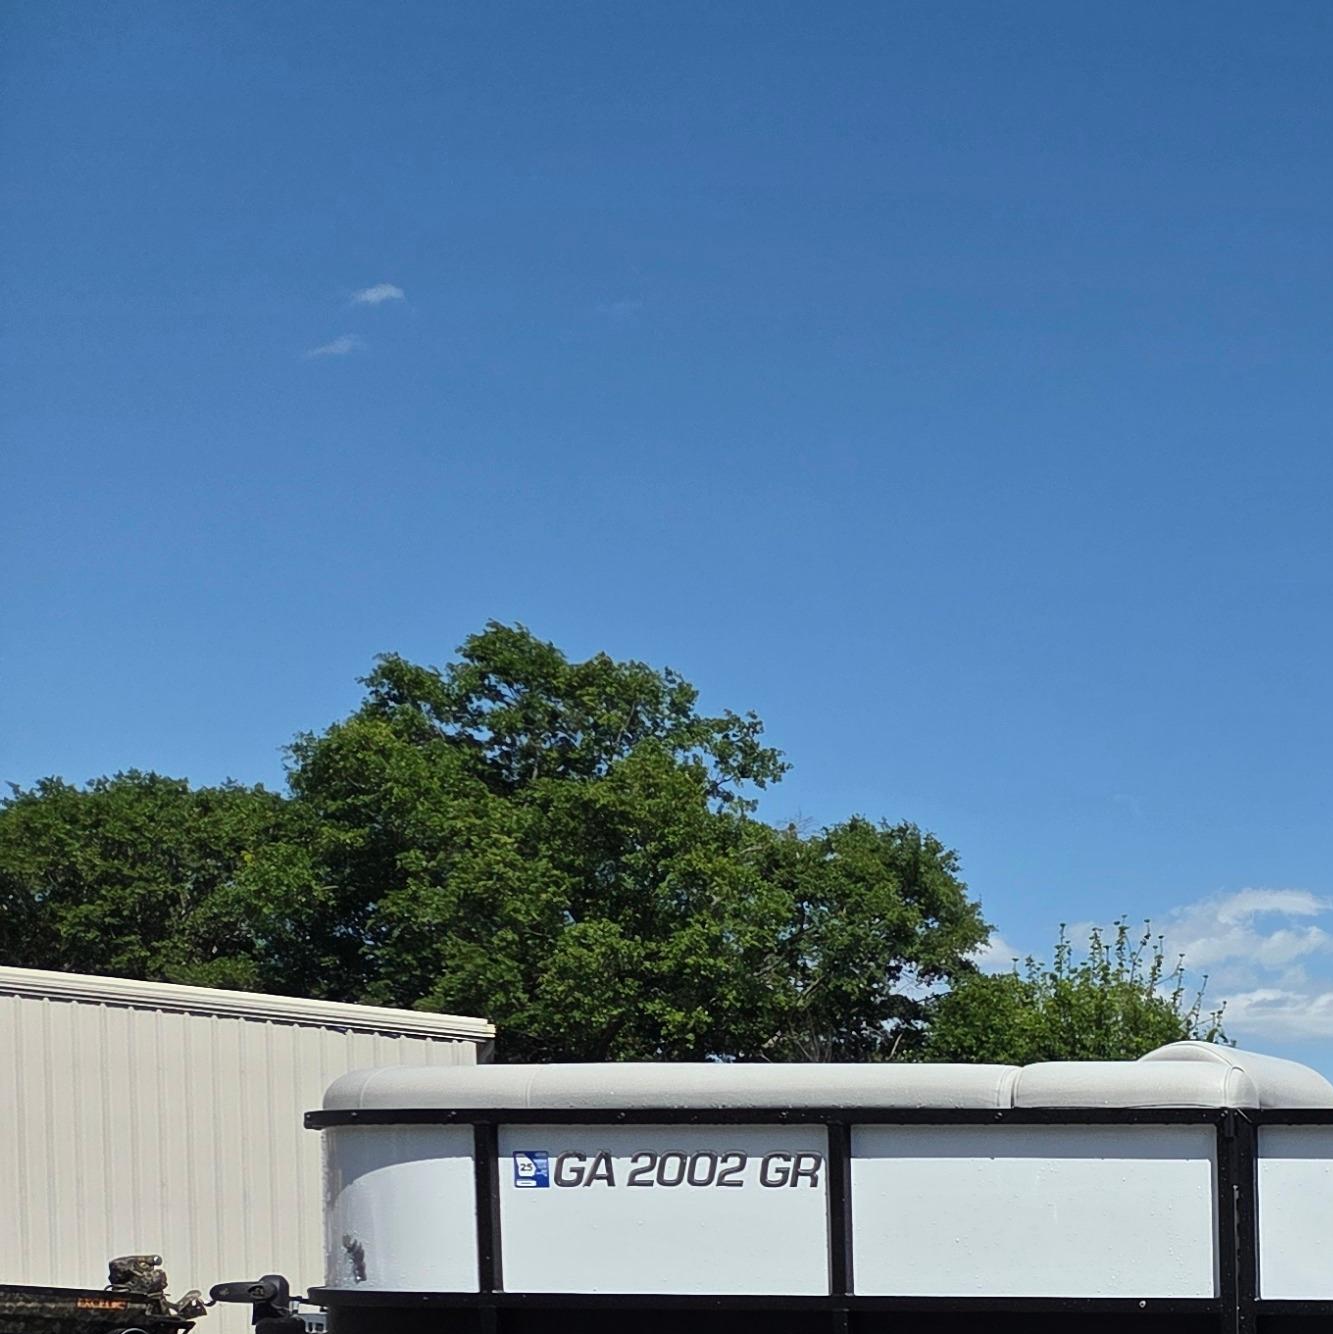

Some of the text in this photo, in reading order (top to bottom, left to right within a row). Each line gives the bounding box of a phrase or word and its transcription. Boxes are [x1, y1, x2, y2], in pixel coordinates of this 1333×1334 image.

[520, 1162, 533, 1172] 25
[553, 1151, 822, 1188] GA 2002 GR
